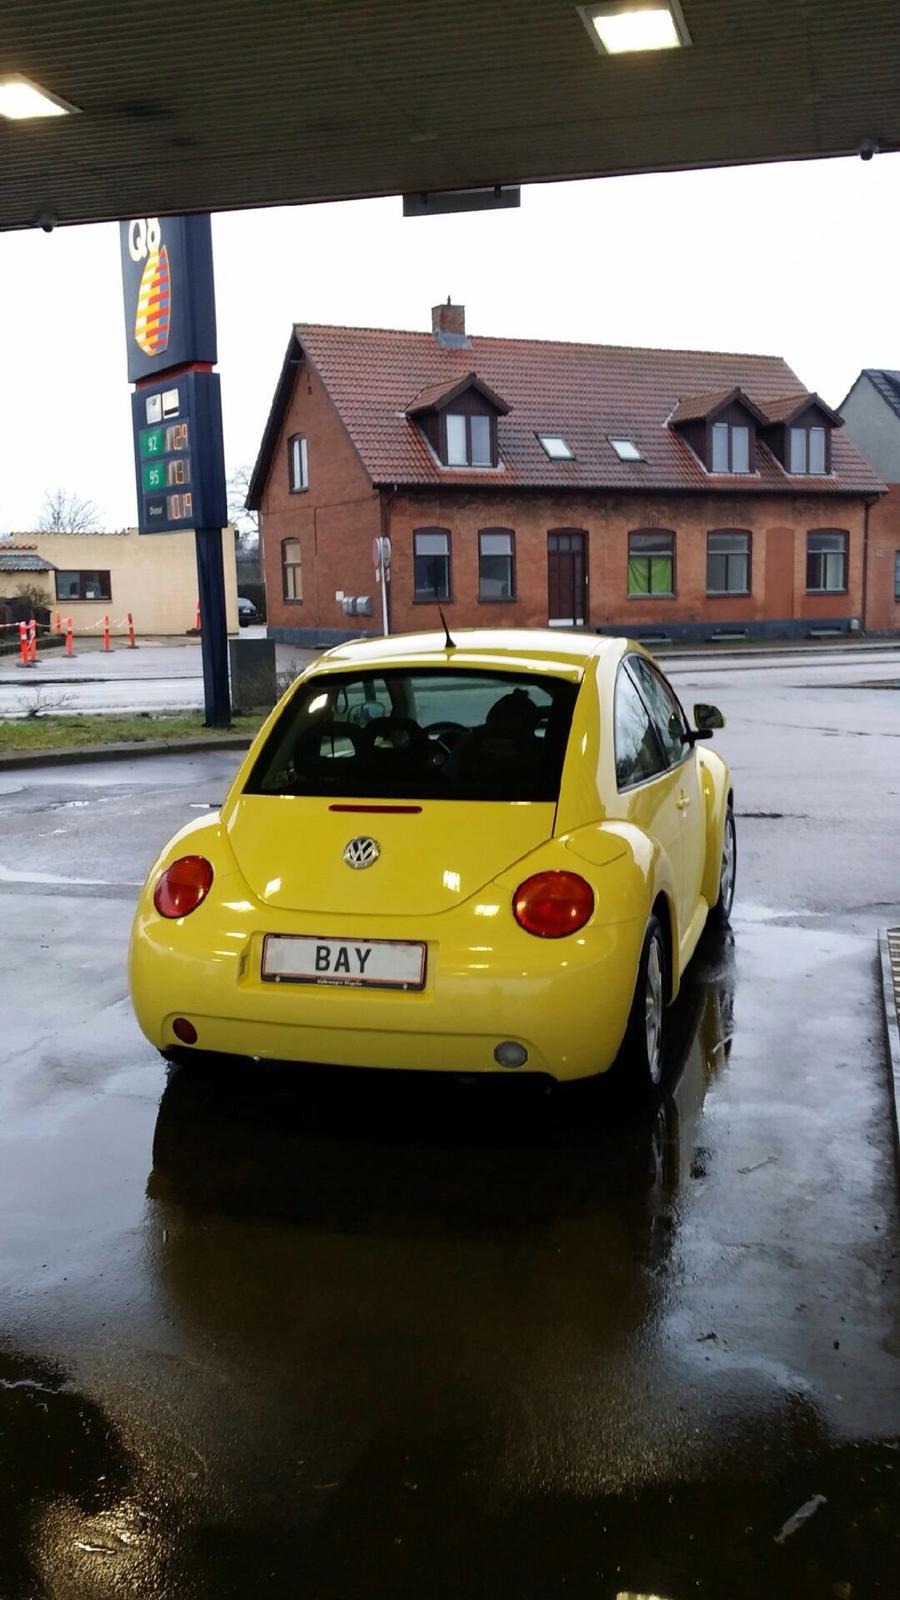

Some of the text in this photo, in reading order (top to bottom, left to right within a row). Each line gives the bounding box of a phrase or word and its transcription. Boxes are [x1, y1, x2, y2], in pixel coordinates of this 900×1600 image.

[148, 436, 158, 451] 92
[149, 470, 159, 485] 95
[315, 945, 372, 974] BAY
